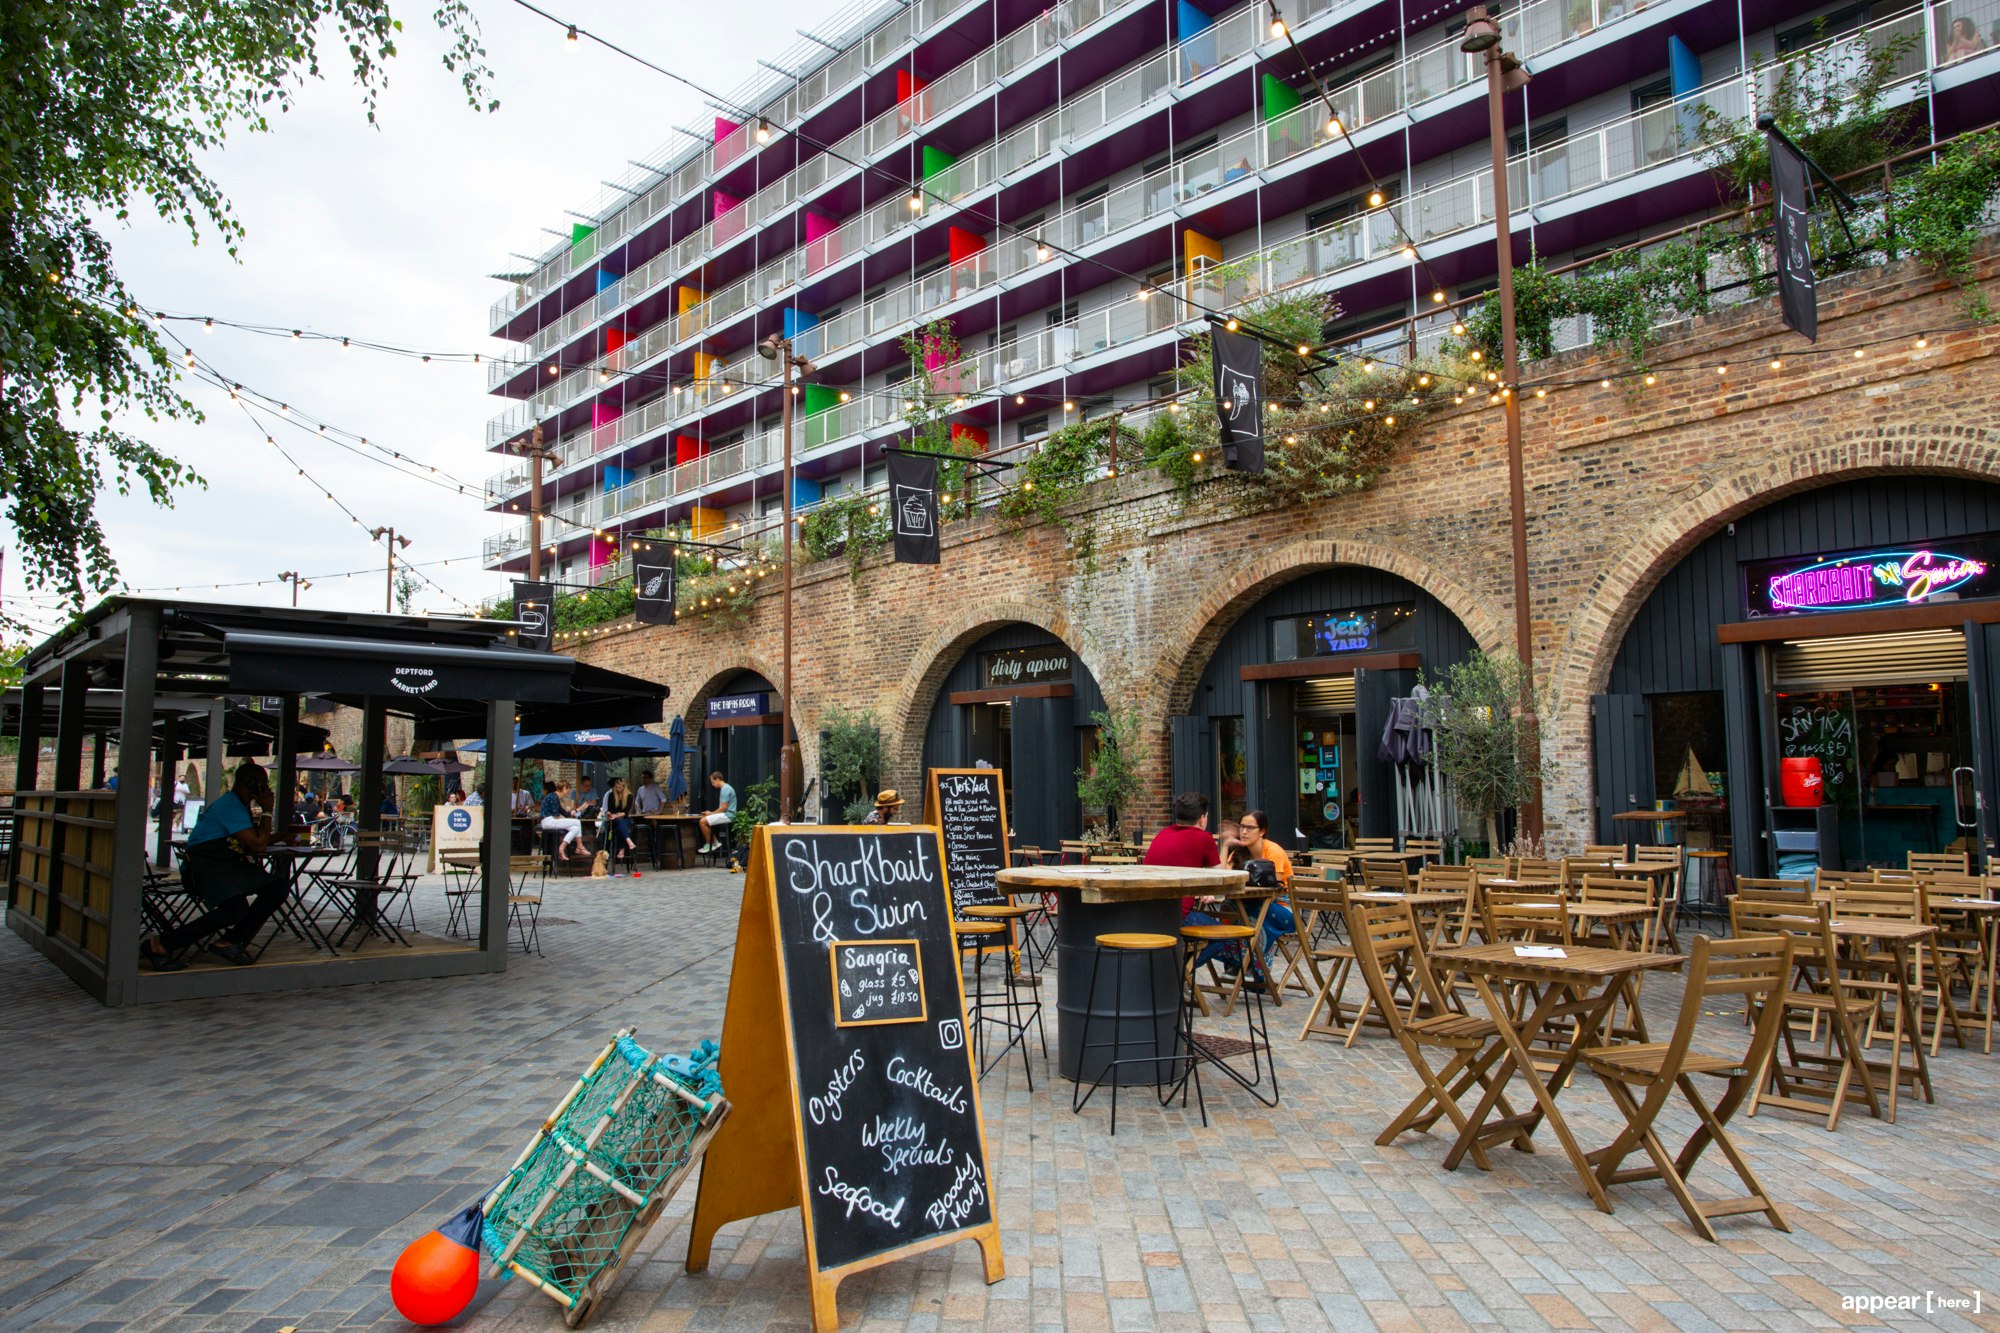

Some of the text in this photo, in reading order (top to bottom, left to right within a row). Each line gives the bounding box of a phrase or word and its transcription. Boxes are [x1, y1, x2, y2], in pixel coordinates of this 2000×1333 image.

[1770, 565, 1873, 608] SHARKBAIT
[1901, 550, 1985, 603] Swim
[1324, 615, 1370, 640] Jerk
[1328, 637, 1368, 652] YARD
[395, 667, 433, 676] DEPTFORD
[991, 657, 1068, 680] dirty apron
[390, 677, 438, 694] MARKET YARD
[710, 698, 756, 711] THE TAPAS ROOM
[1780, 707, 1852, 743] SANGRIA
[1825, 740, 1846, 756] £5
[946, 776, 971, 797] Jerk
[967, 776, 990, 795] Yard
[785, 835, 933, 894] Sharkbait
[813, 888, 927, 942] & Swim
[845, 947, 910, 976] Sangria
[858, 971, 906, 992] glass £5
[865, 989, 918, 1007] jug £18.50
[809, 1048, 865, 1125] Oysters
[886, 1056, 968, 1114] Cocktails
[861, 1114, 926, 1150] Weekly
[881, 1138, 954, 1176] Specials
[818, 1166, 905, 1228] Seafood
[925, 1153, 977, 1229] Bloody
